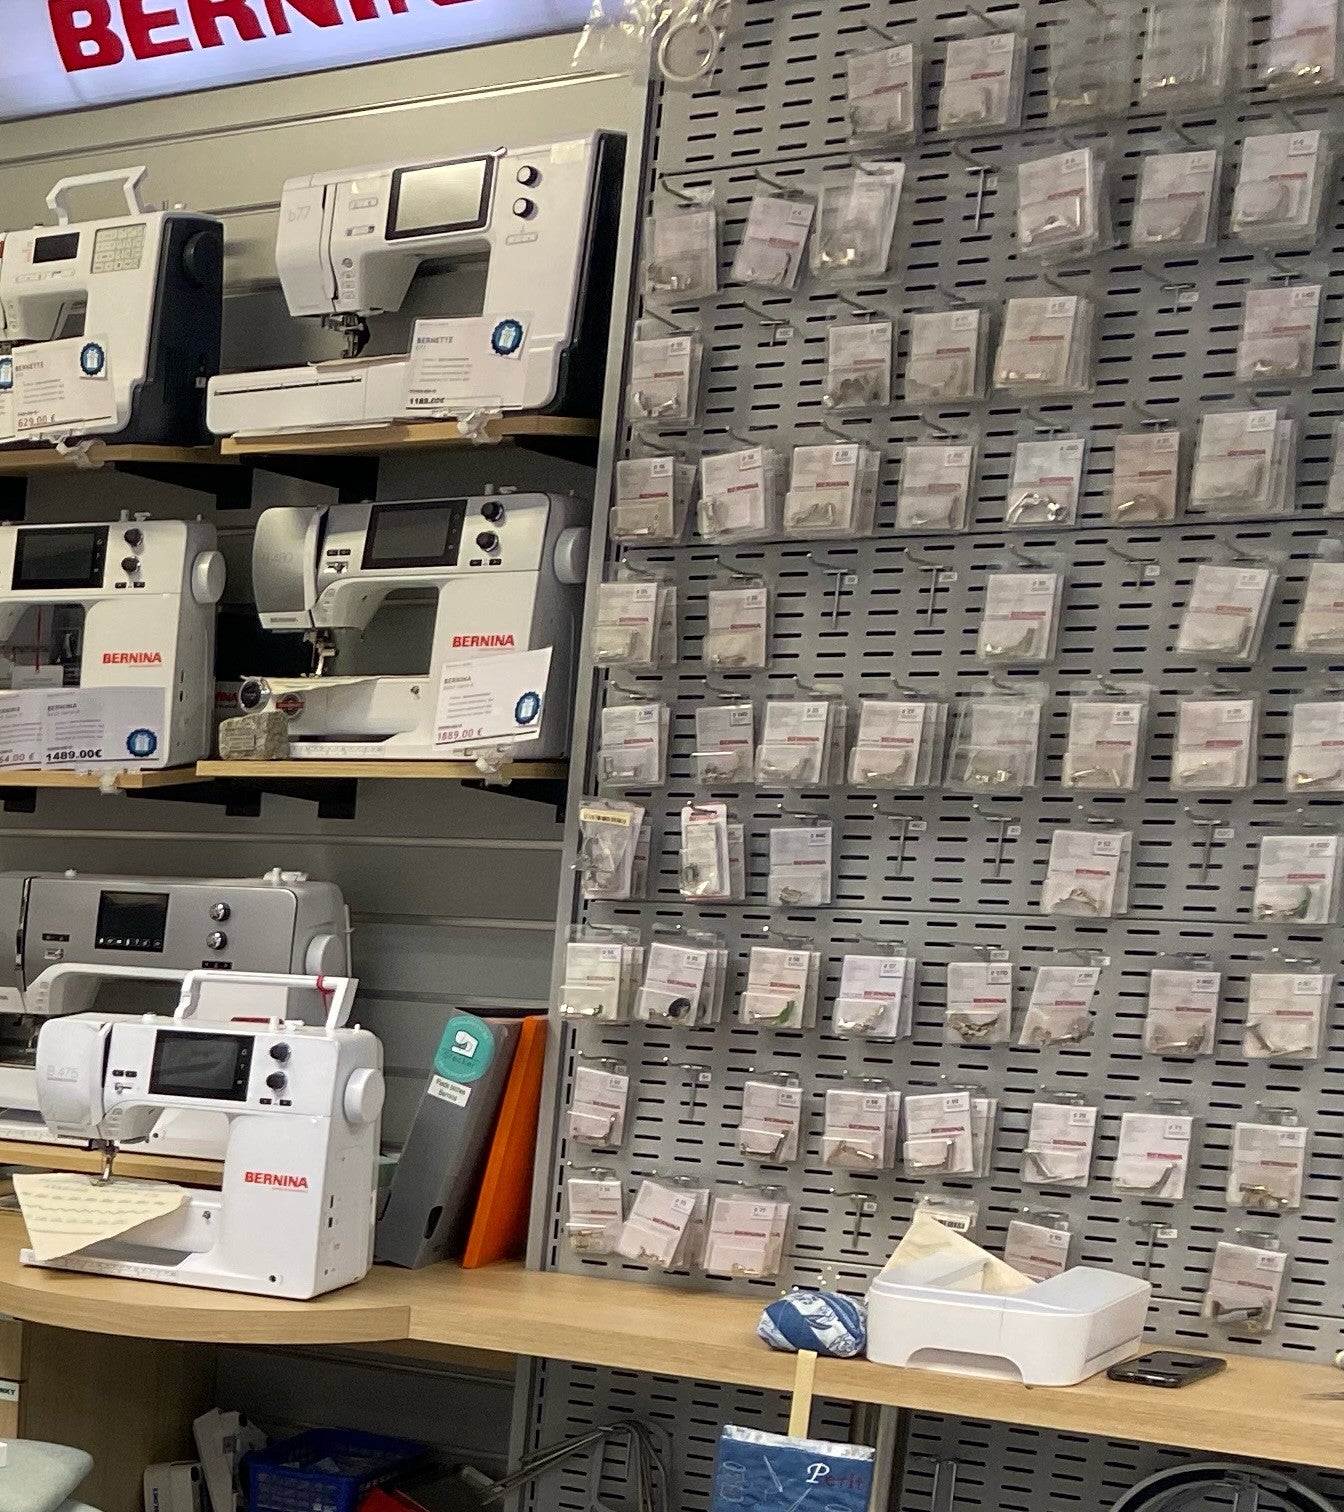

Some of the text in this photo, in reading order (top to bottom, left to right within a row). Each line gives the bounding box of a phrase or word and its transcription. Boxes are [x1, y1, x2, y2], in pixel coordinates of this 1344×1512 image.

[14, 361, 45, 373] BERNETTE
[17, 413, 56, 427] 629.00 €
[451, 634, 516, 648] BERNINA
[102, 650, 163, 666] BERNINA
[476, 727, 484, 737] €
[45, 749, 103, 763] 1489.00€
[244, 1169, 309, 1191] BERNINA
